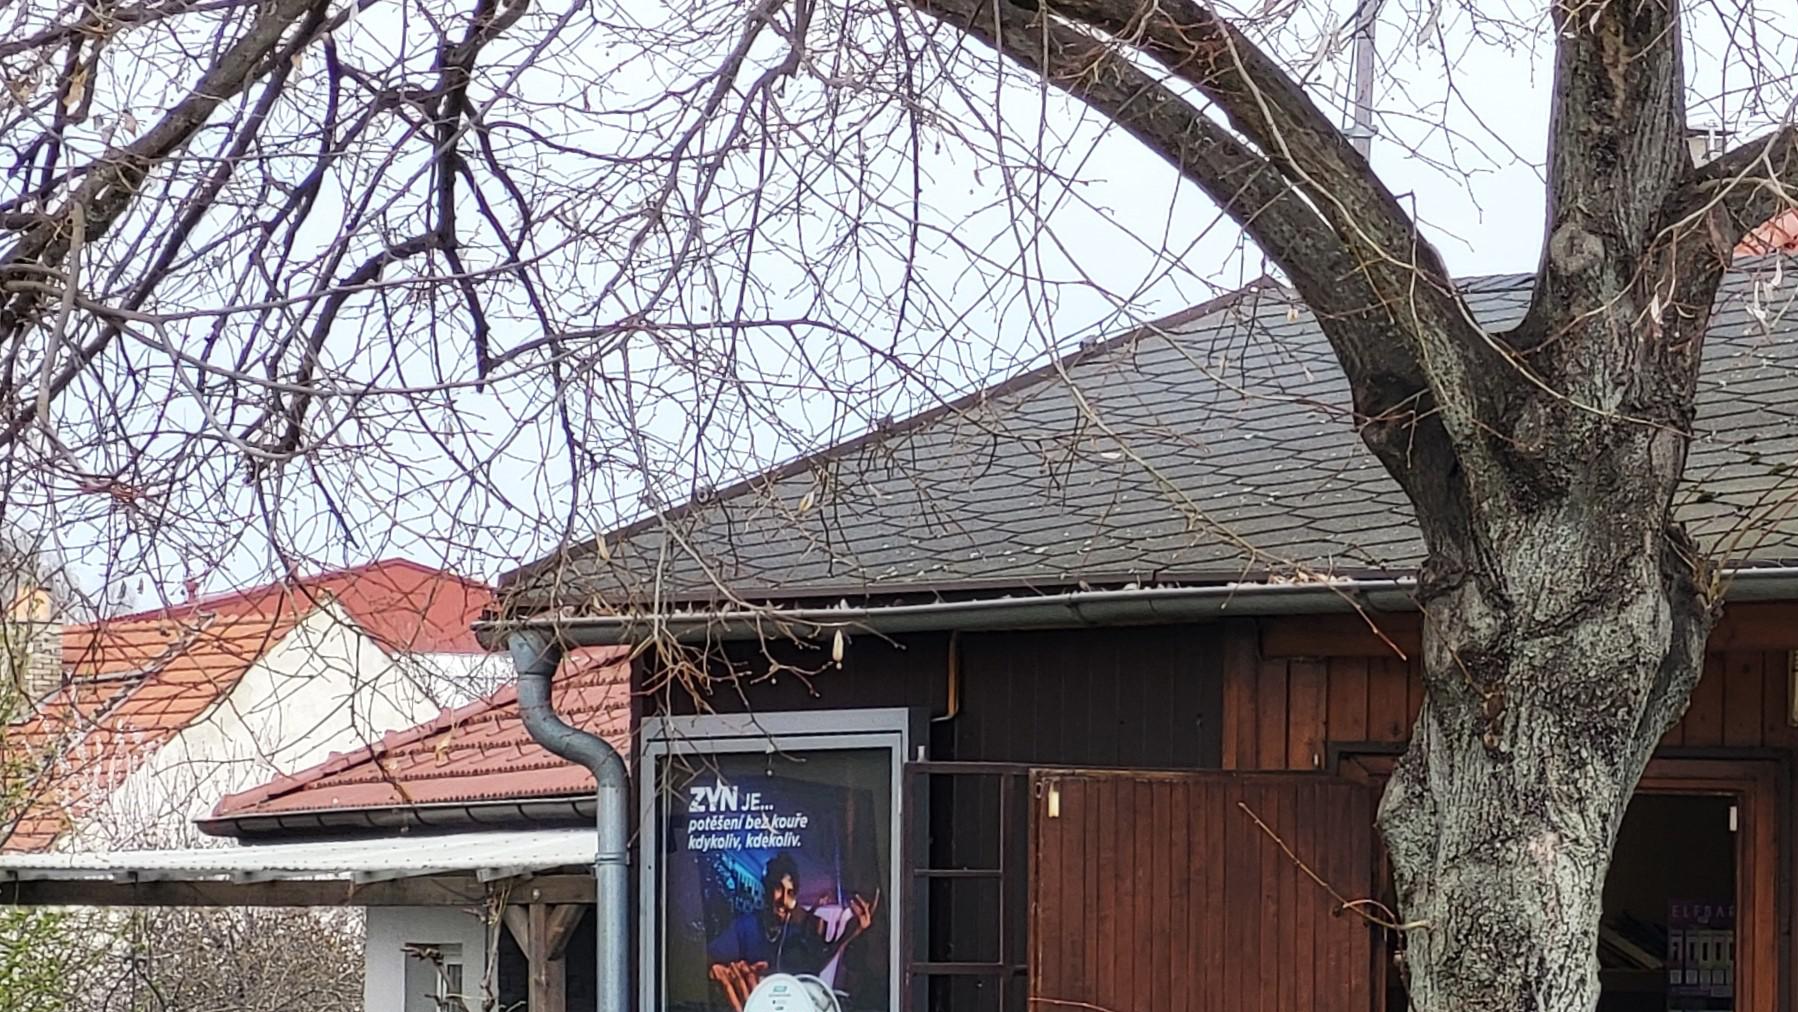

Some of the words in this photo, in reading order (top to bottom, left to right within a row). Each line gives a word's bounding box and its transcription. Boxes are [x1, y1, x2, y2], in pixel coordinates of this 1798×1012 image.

[688, 785, 739, 813] ZYN
[741, 793, 774, 811] JE...
[688, 813, 743, 834] potěšení
[771, 812, 808, 829] kouře
[688, 832, 742, 851] kdykoliv,
[745, 831, 802, 849] kdekoliv.
